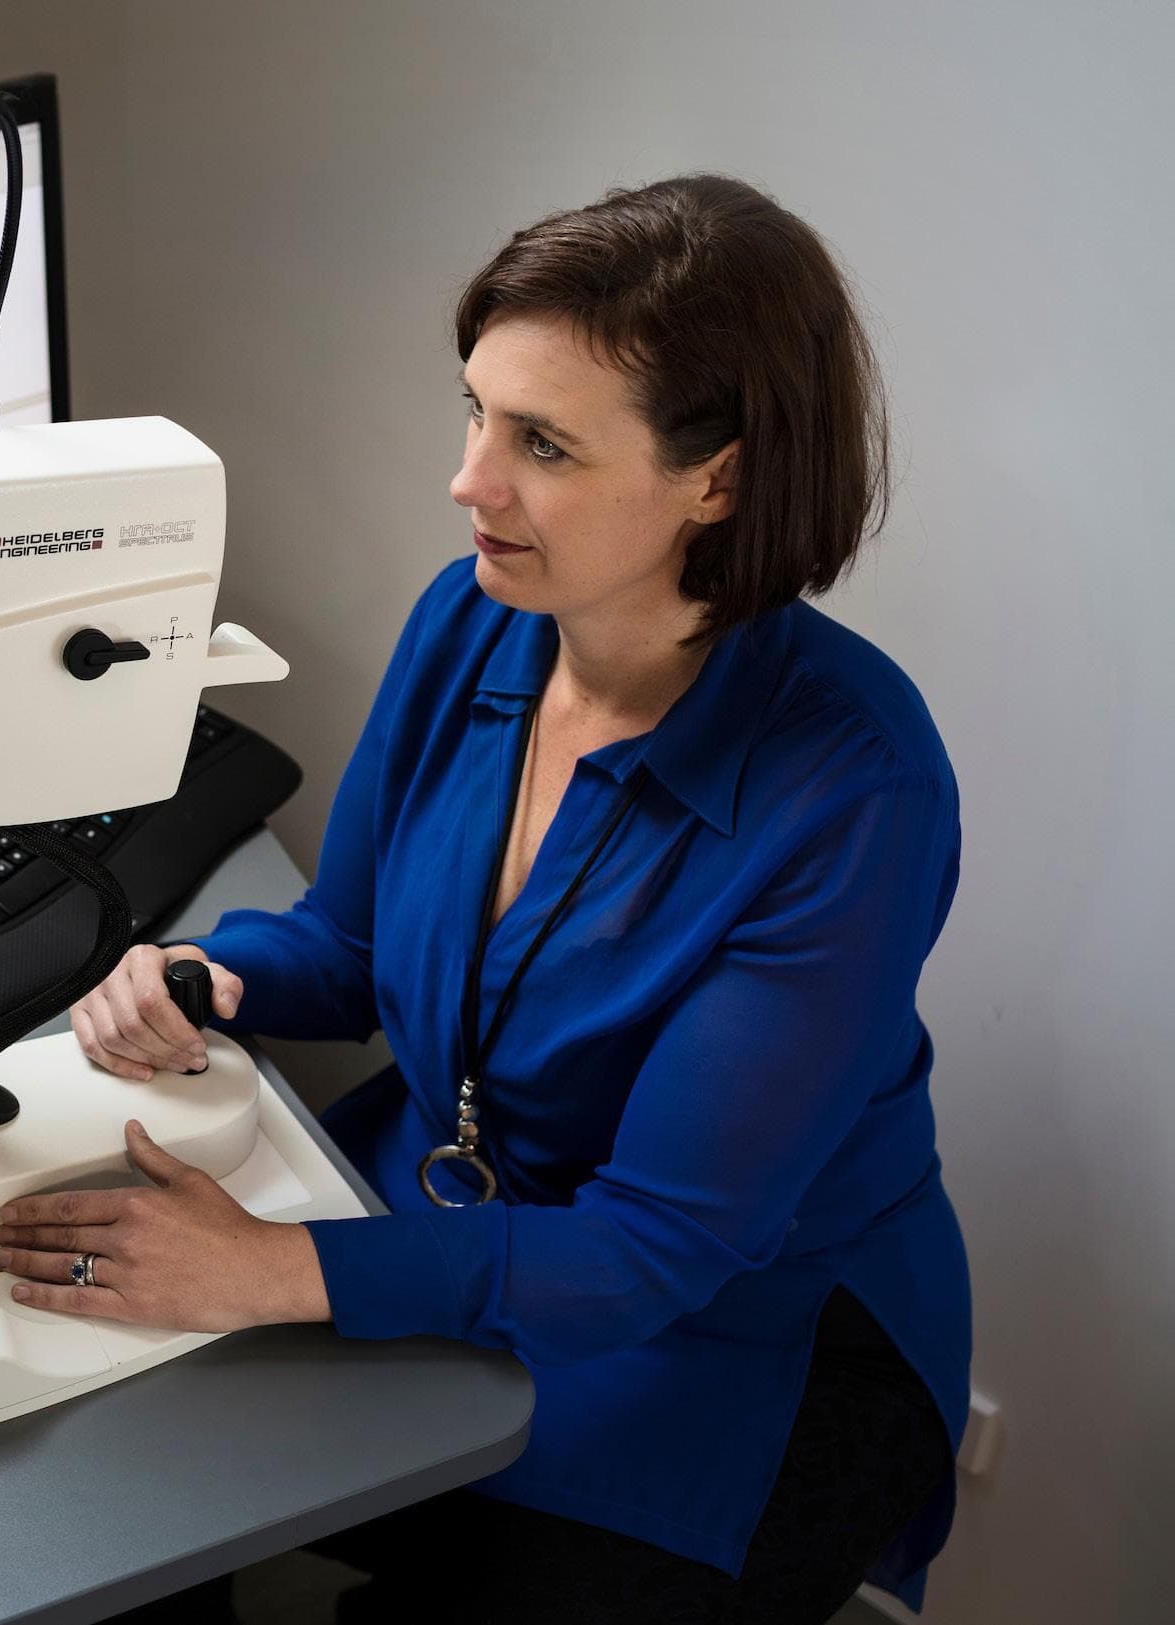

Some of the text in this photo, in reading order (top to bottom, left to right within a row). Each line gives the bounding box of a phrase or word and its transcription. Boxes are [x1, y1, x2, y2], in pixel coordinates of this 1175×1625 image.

[2, 528, 105, 547] HEIDELBERG
[170, 616, 179, 624] P
[185, 632, 194, 640] A
[166, 652, 175, 660] S
